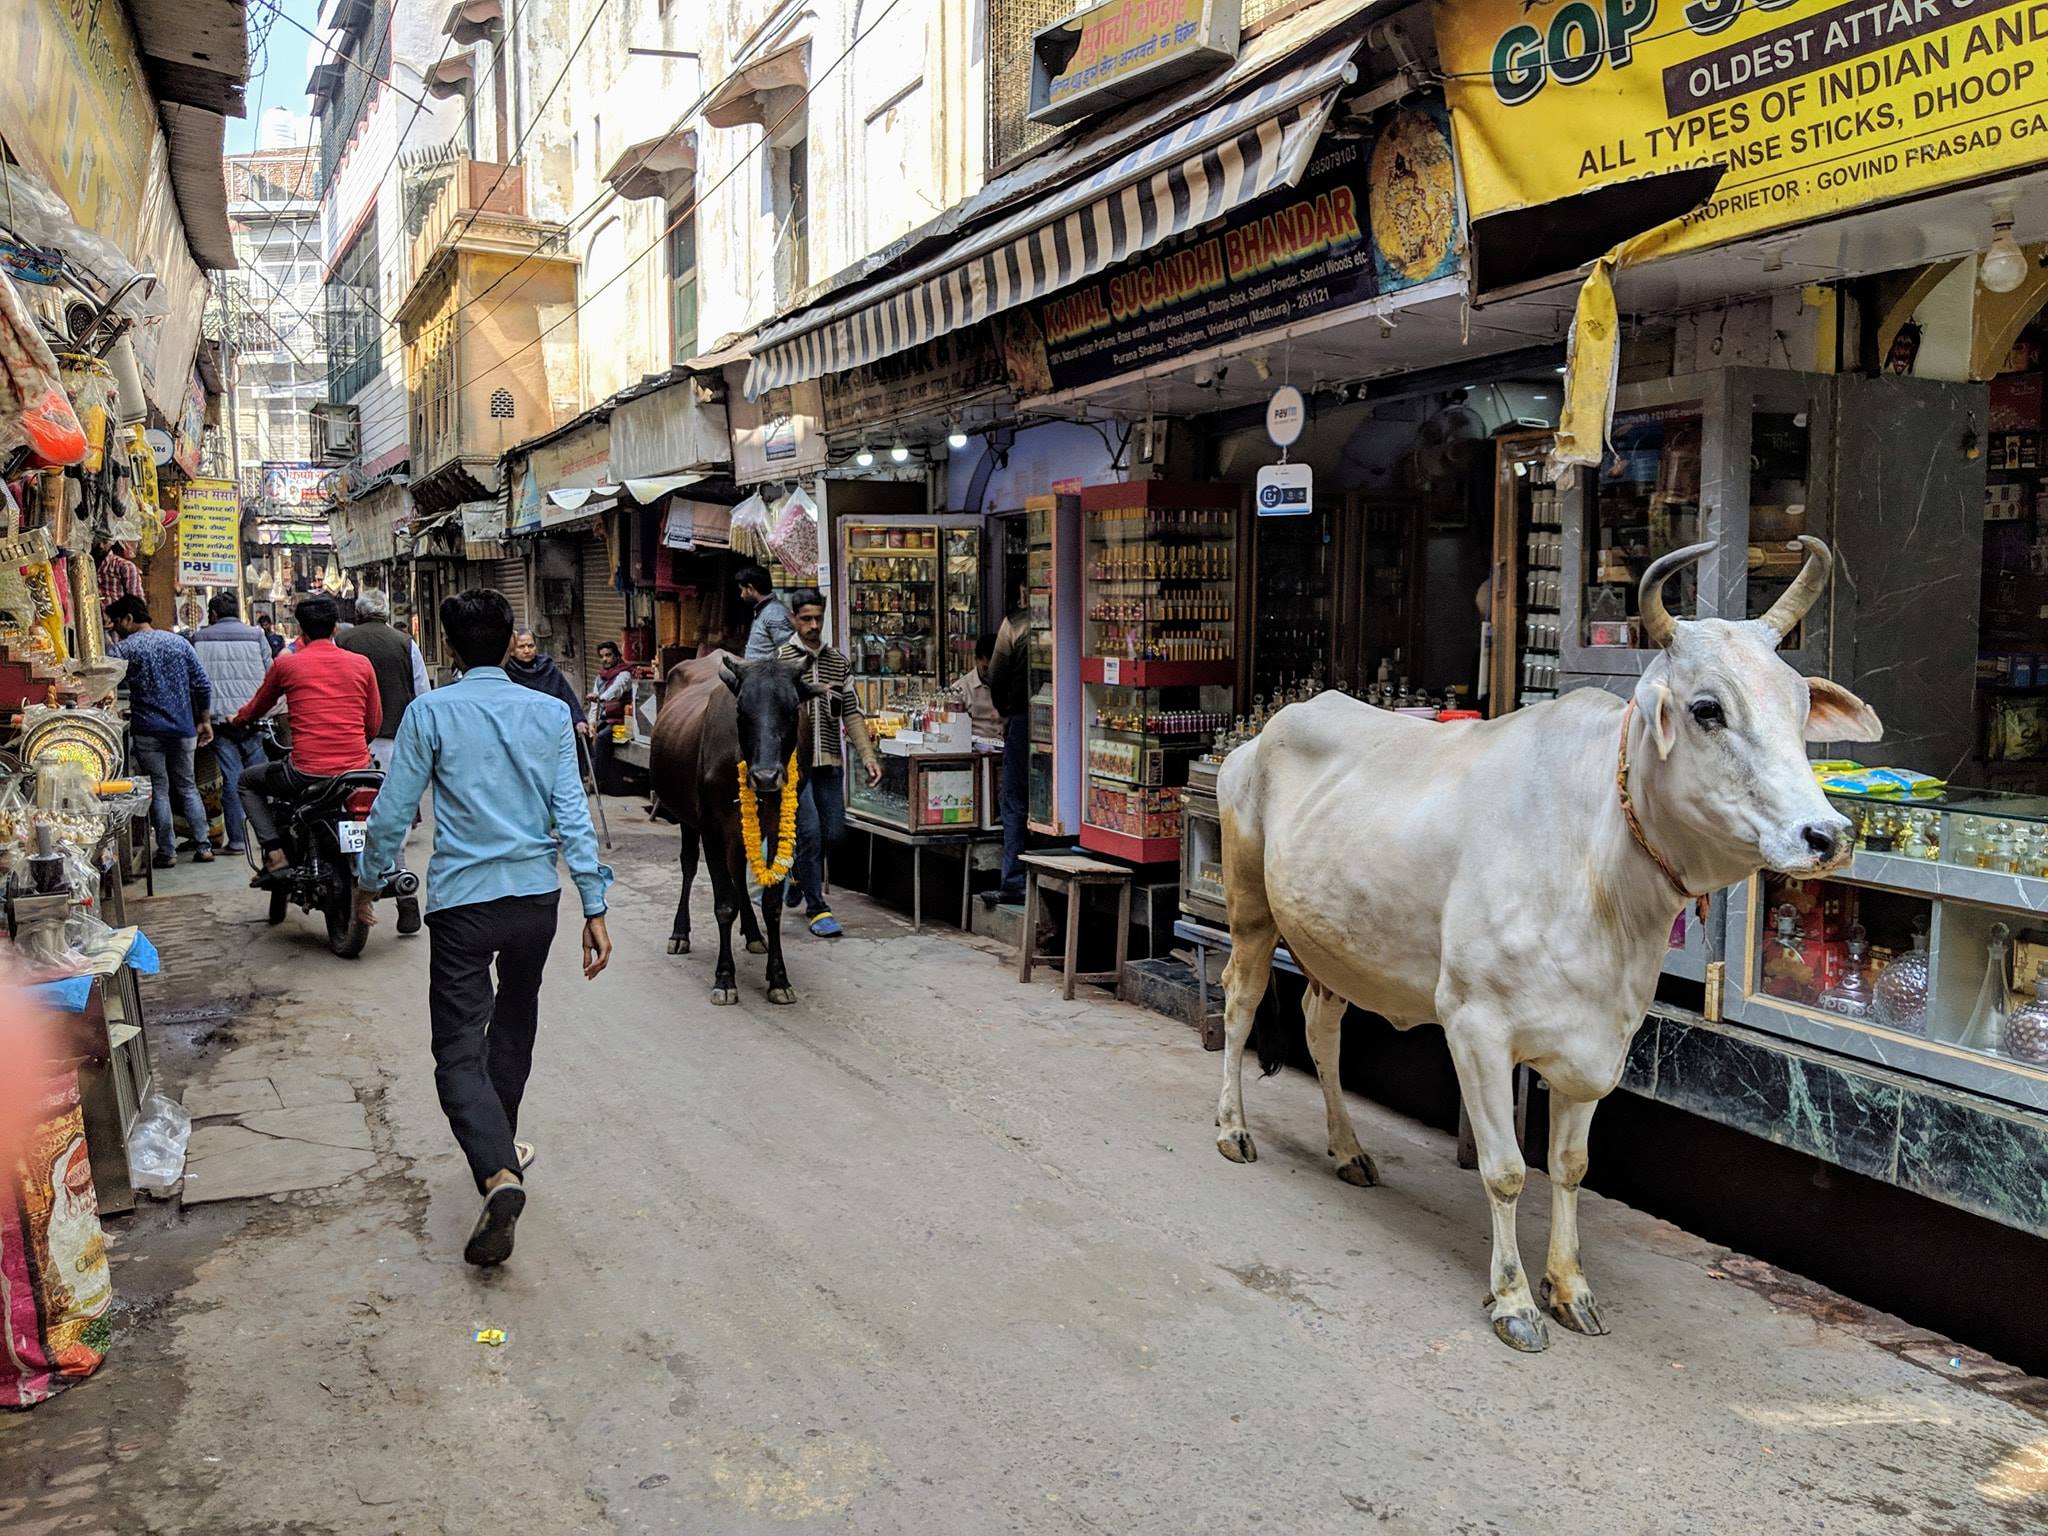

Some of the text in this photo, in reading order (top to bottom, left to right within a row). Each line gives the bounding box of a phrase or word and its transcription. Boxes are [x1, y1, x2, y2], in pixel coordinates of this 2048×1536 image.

[1688, 0, 1941, 97] OLDEST ATTAR
[1577, 5, 2048, 179] ALL TYPES OF INDIAN AND
[1790, 103, 1903, 154] STICKS,
[1914, 60, 2034, 119] DHOOP
[1308, 144, 1357, 178] 895079103
[1817, 154, 1898, 190] GOVIND
[1043, 185, 1363, 346] KAMAL SUGANDHI BHANDAR
[1249, 283, 1272, 300] Sandal
[1300, 265, 1326, 283] Sandal
[1326, 255, 1353, 274] Woods
[1207, 314, 1249, 336] Vrindavan
[1249, 300, 1291, 323] (Mathura)
[1298, 287, 1330, 309] 281121
